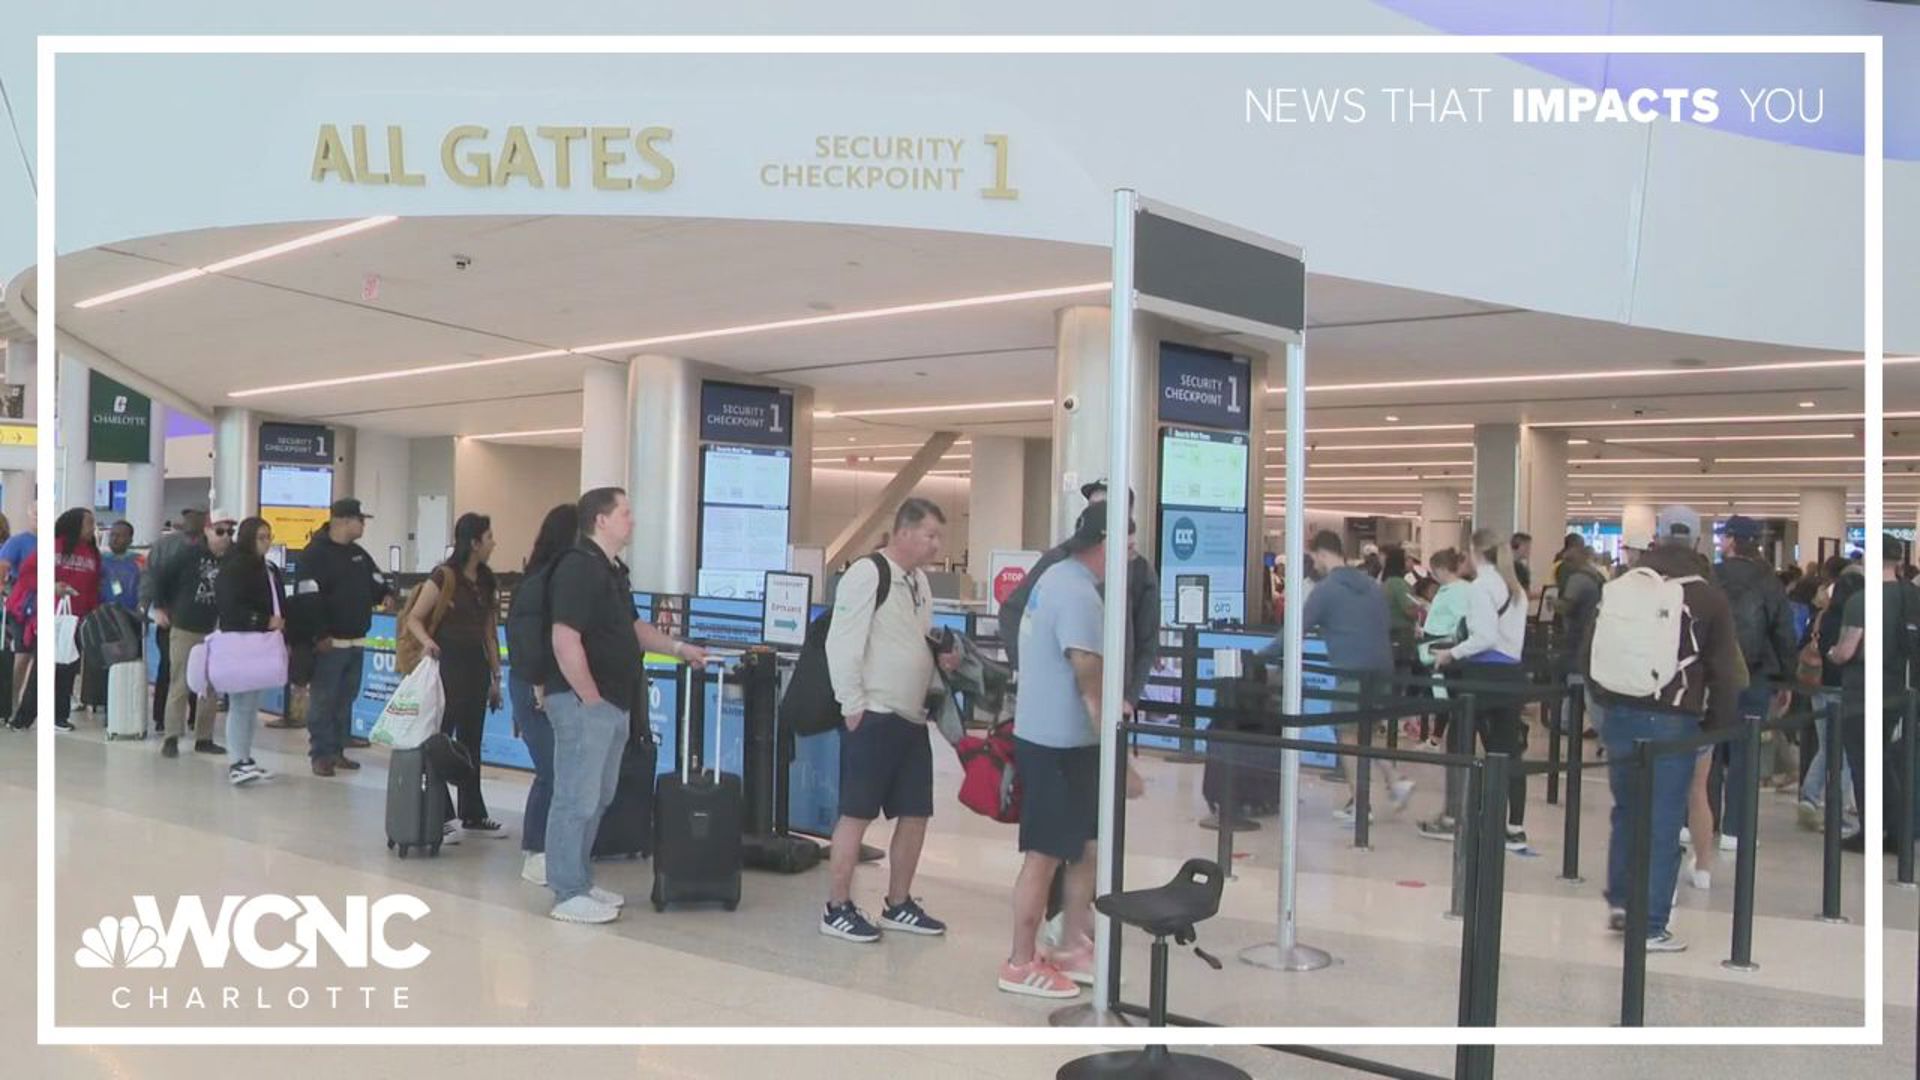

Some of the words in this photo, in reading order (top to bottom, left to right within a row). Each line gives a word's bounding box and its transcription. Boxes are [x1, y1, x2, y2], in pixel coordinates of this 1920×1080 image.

[311, 123, 425, 186] ALL
[440, 125, 676, 191] GATES
[815, 135, 966, 162] SECURITY
[760, 163, 965, 191] CHECKPOINT
[981, 133, 1019, 201] 1
[1180, 374, 1222, 391] SECURITY
[1164, 386, 1222, 407] CHECKPOINT
[1227, 375, 1241, 413] 1
[93, 414, 148, 427] CHARLOTTE
[722, 403, 766, 417] SECURITY
[769, 403, 784, 433] 1
[707, 414, 766, 428] CHECKPOINT
[264, 444, 312, 454] CHECKPOINT
[277, 436, 313, 446] SECURITY
[315, 436, 328, 457] 1
[1001, 572, 1024, 582] STOP
